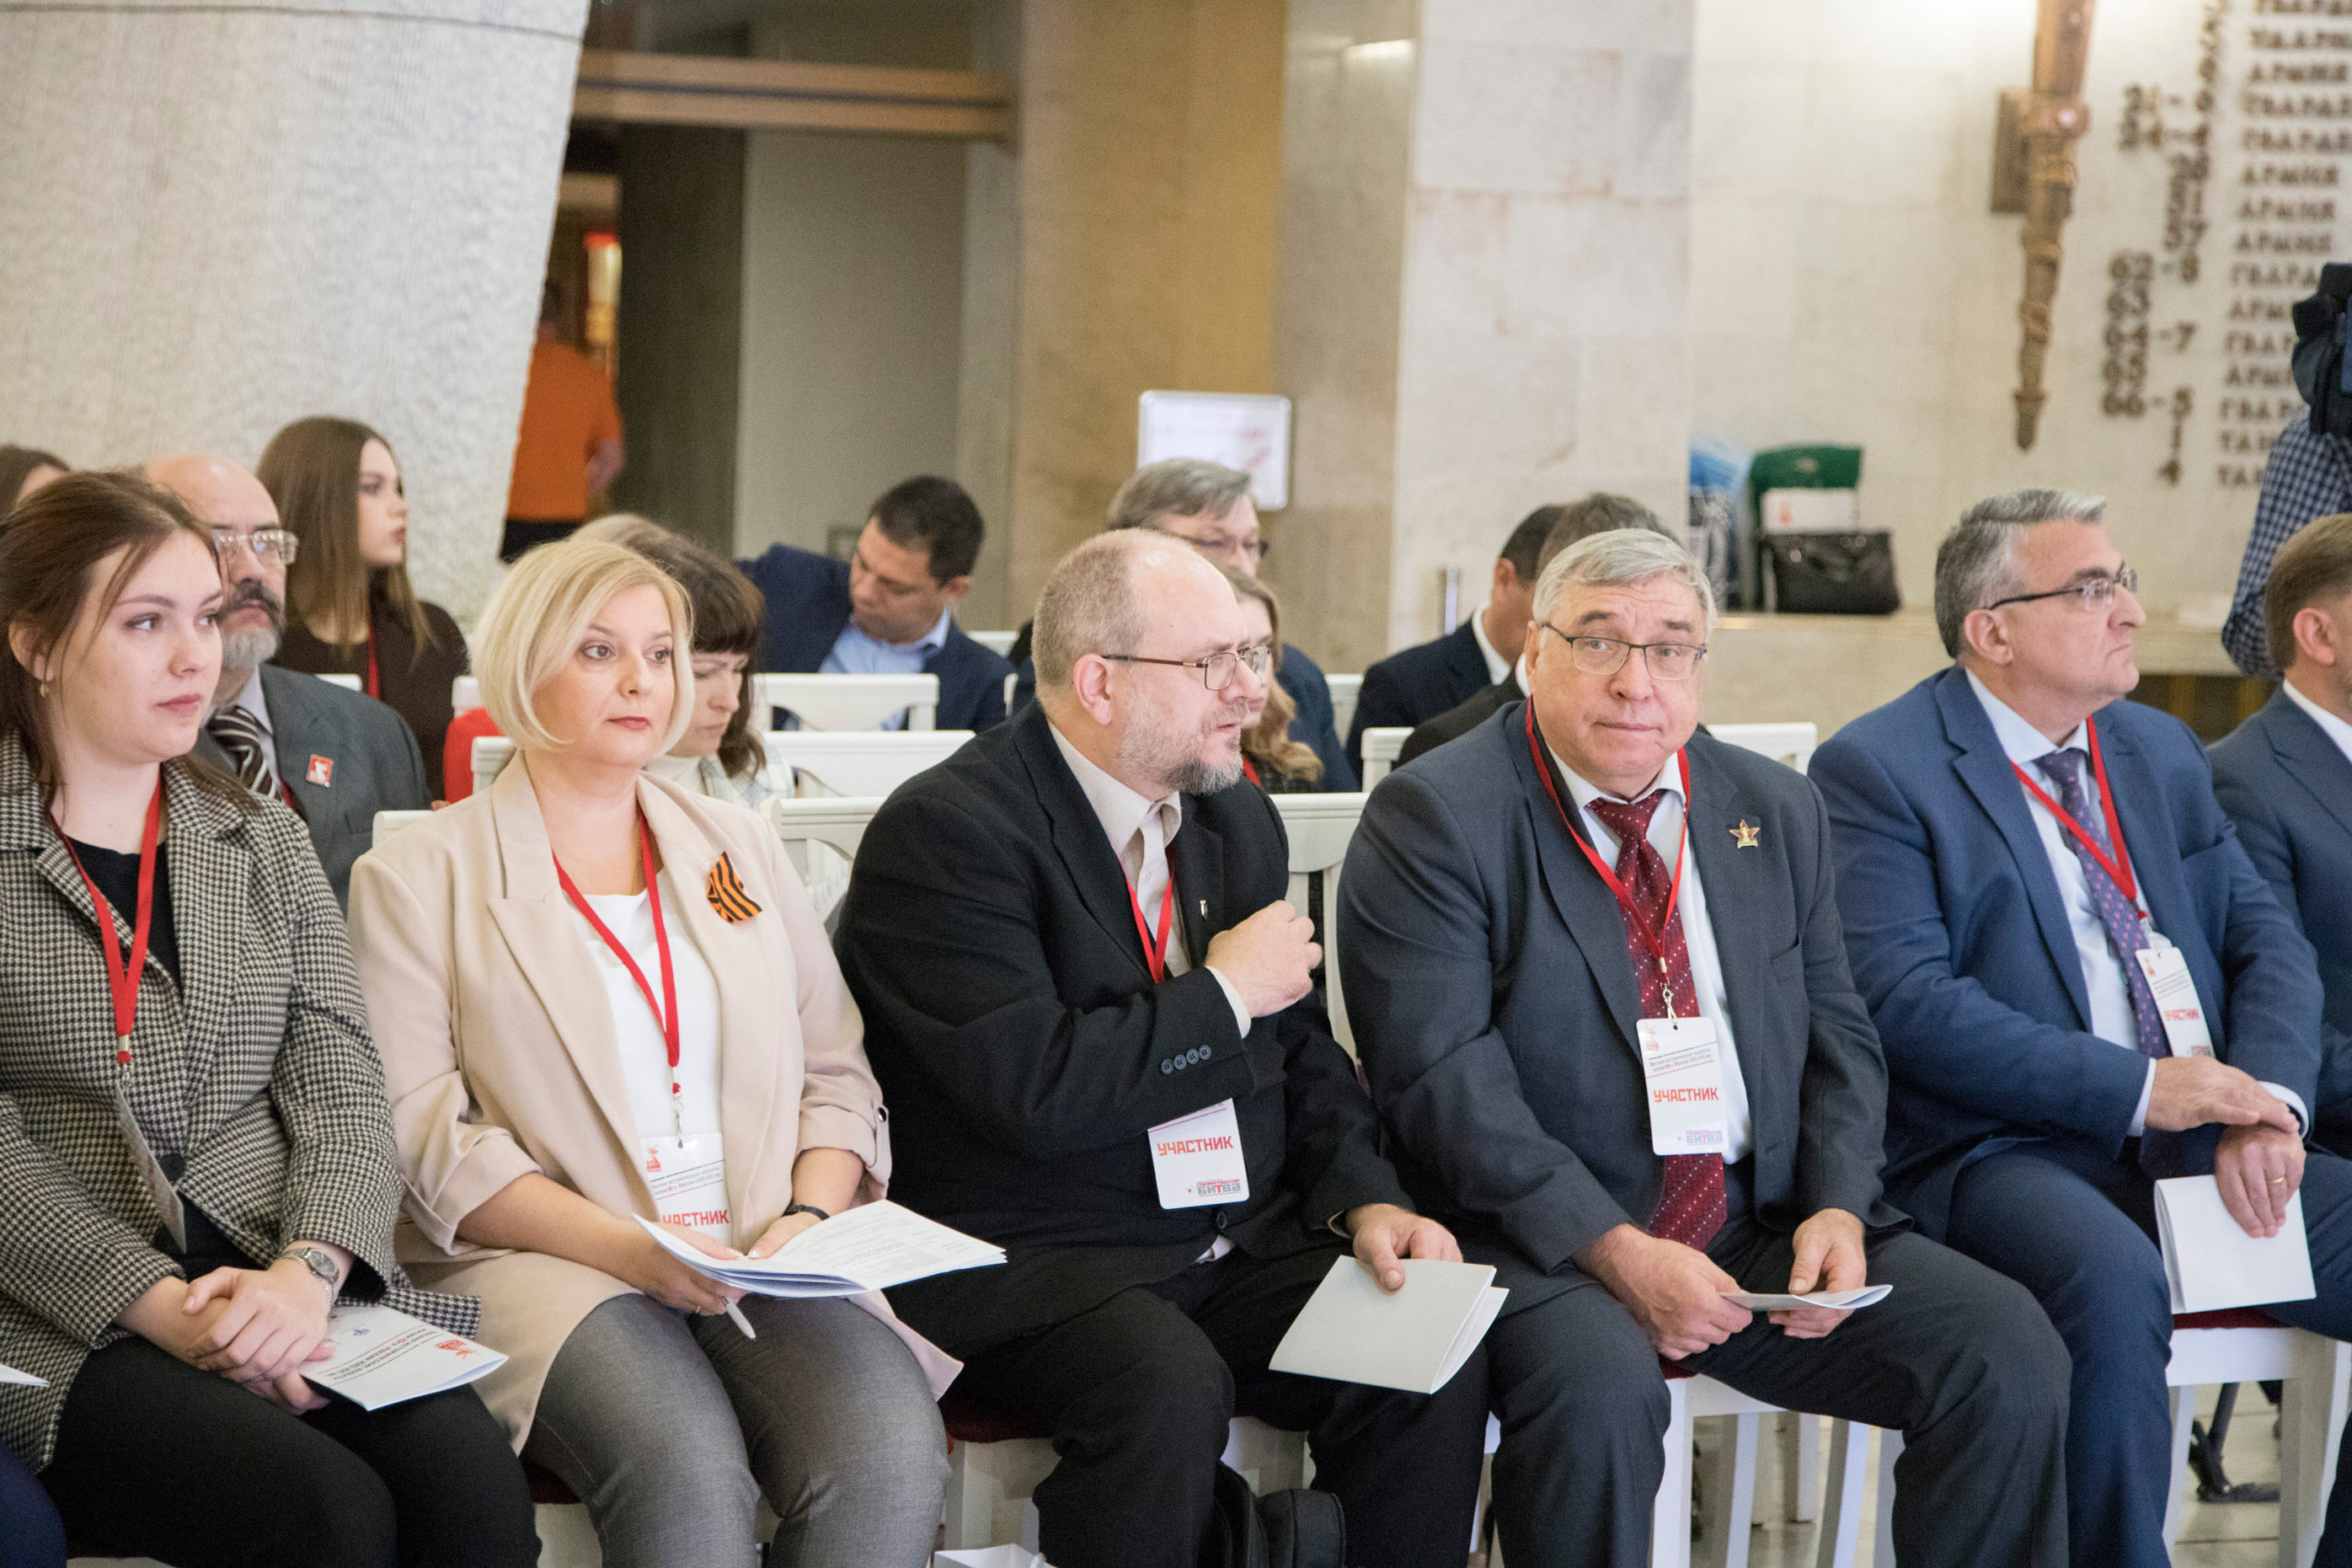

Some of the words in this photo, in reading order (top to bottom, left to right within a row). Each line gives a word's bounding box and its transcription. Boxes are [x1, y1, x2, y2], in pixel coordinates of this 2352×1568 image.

[2241, 164, 2340, 186] АРМИЯ
[2237, 197, 2335, 220] АРМИЯ
[2234, 231, 2332, 254] АРМИЯ
[1654, 1088, 1719, 1102] УЧАСТНИК
[1157, 1135, 1234, 1156] УЧАСТНИК
[662, 1209, 729, 1227] ЧАСТНИК
